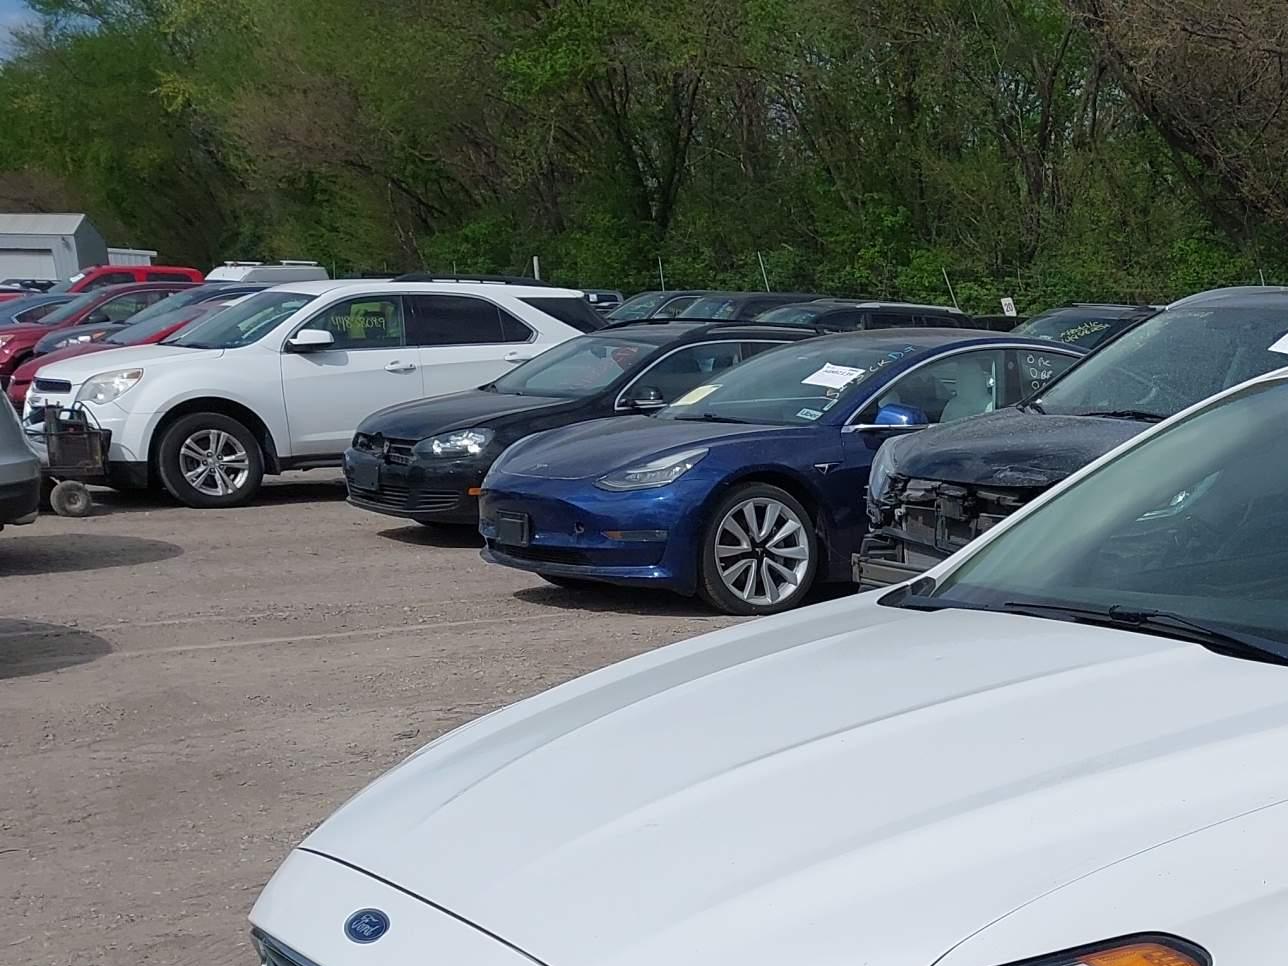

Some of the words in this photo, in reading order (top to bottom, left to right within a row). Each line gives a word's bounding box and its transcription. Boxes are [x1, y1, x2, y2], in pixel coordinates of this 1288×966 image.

[1004, 303, 1014, 313] 20
[800, 409, 819, 419] Uber
[351, 914, 380, 937] Ford
